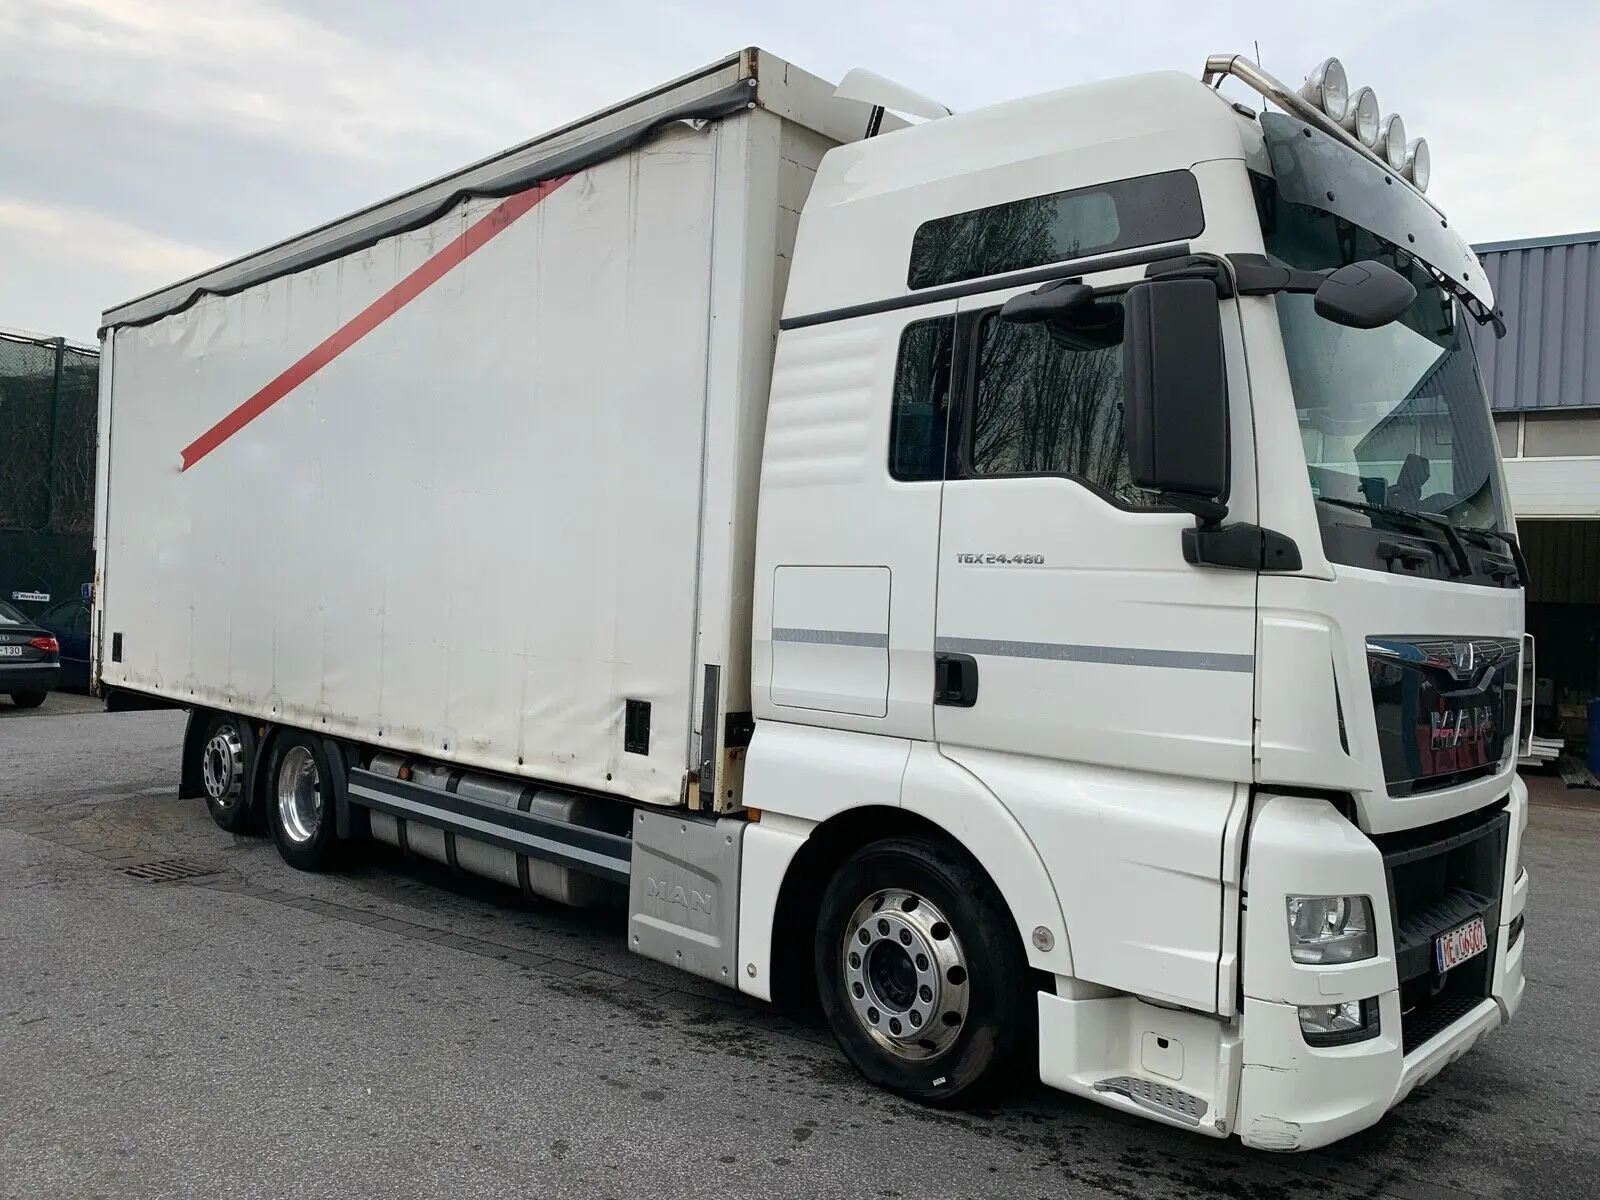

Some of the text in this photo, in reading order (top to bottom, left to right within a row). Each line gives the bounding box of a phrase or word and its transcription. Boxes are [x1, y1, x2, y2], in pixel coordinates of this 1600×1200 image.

[957, 553, 1045, 565] TGX 24.480
[647, 877, 713, 915] MAN
